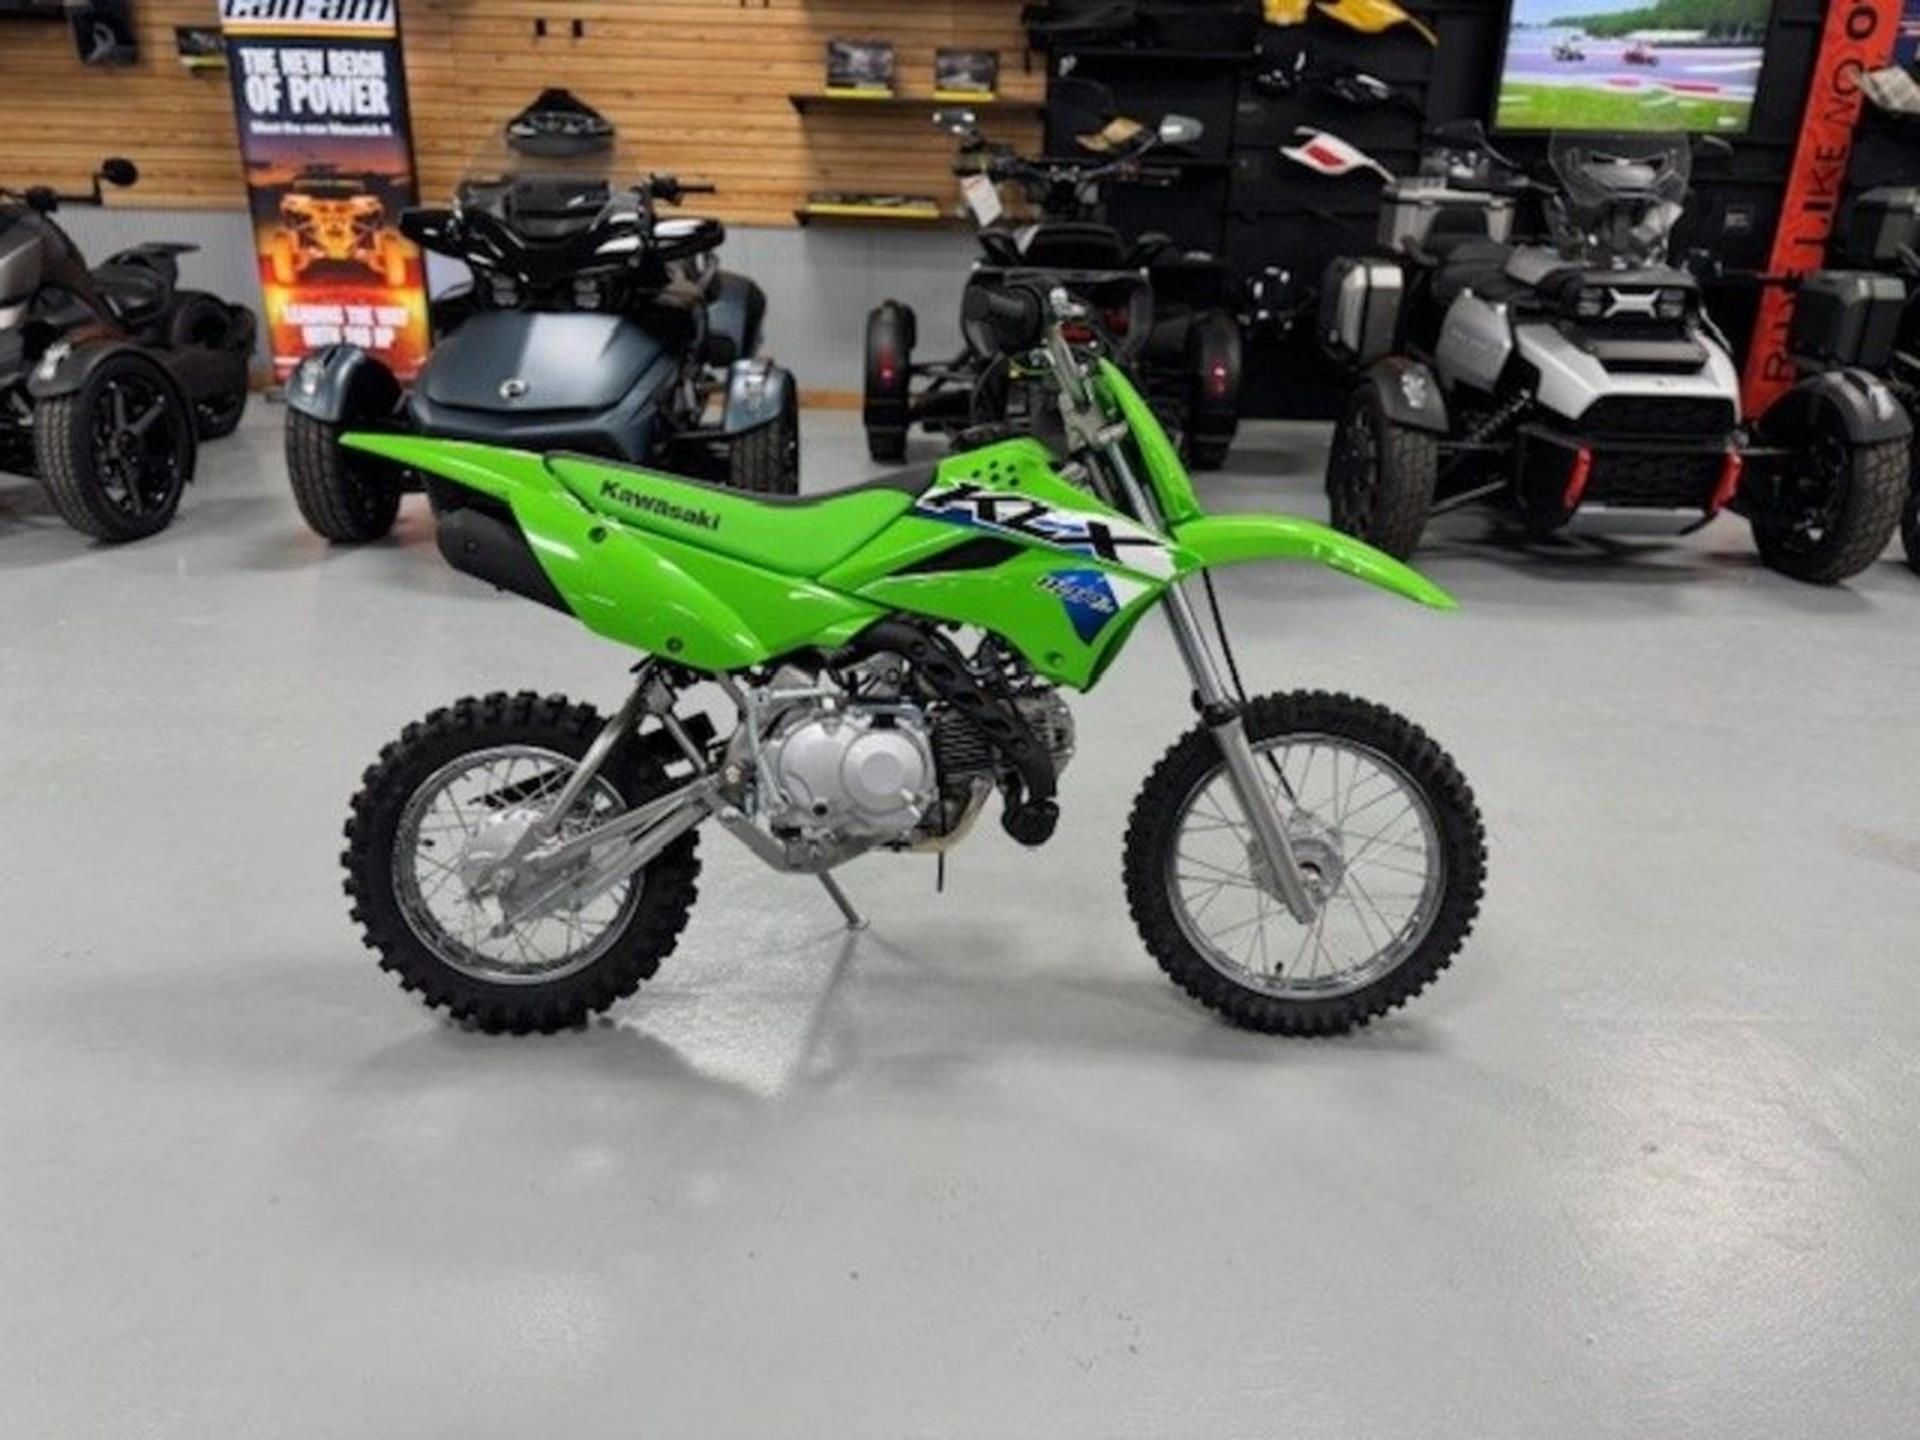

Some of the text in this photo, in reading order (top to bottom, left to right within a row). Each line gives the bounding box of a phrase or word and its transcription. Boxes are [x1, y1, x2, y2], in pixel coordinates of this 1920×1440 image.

[239, 48, 281, 75] THE
[279, 49, 325, 76] NEW
[245, 75, 390, 116] OF POWER
[1794, 145, 1846, 246] LIKE
[1823, 58, 1865, 128] NO
[600, 479, 720, 531] Kawasaki
